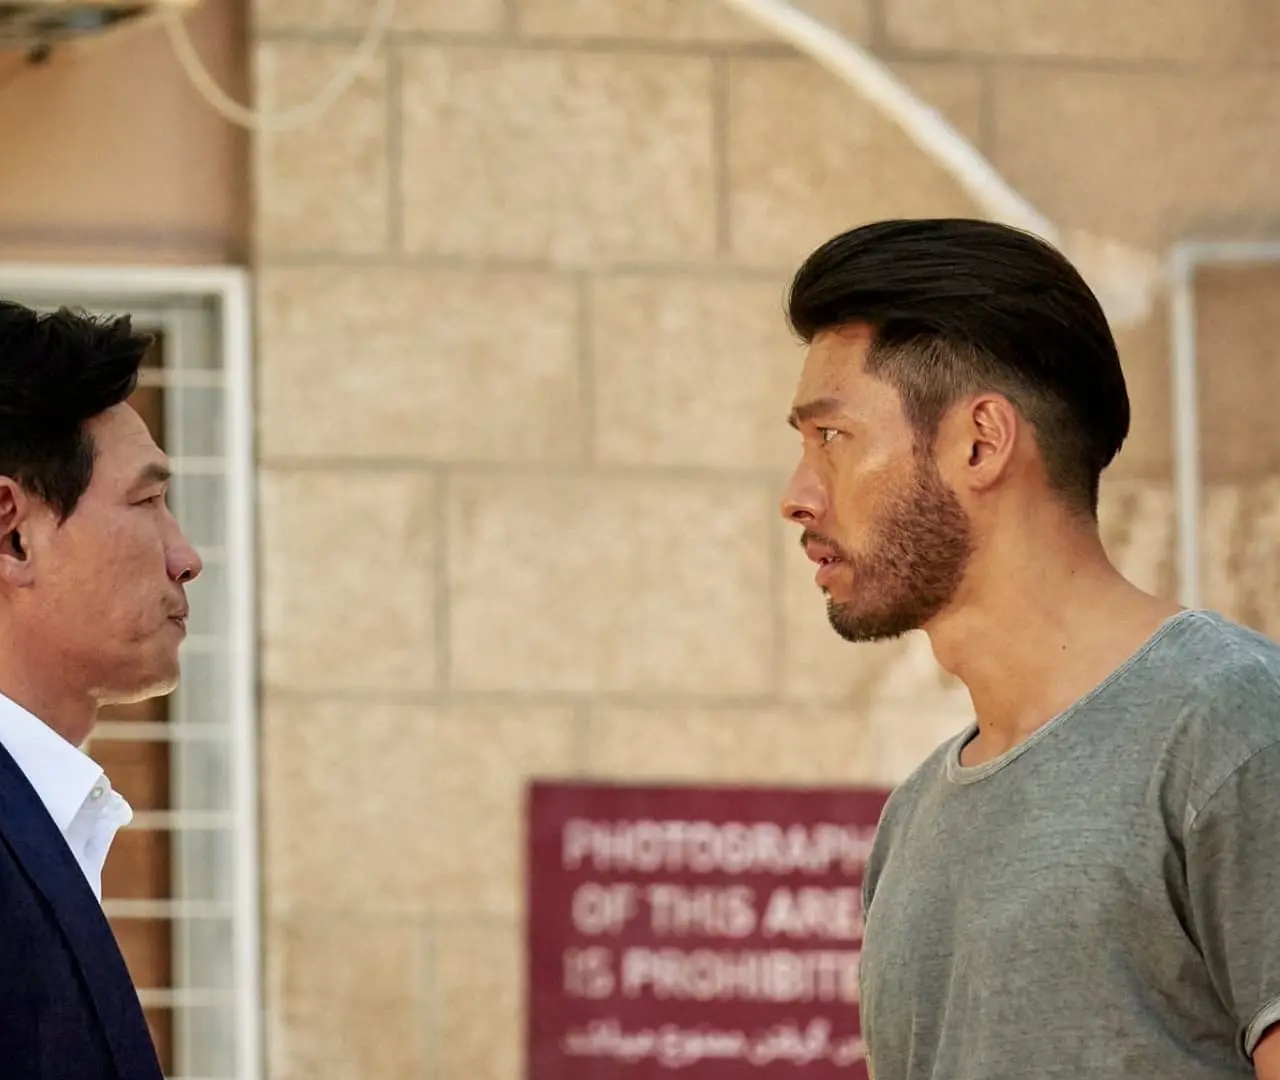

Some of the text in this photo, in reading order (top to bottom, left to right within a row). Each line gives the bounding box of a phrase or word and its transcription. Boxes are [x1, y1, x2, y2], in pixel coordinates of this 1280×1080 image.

[572, 882, 863, 940] OF THIS ARE
[563, 947, 614, 998] IS
